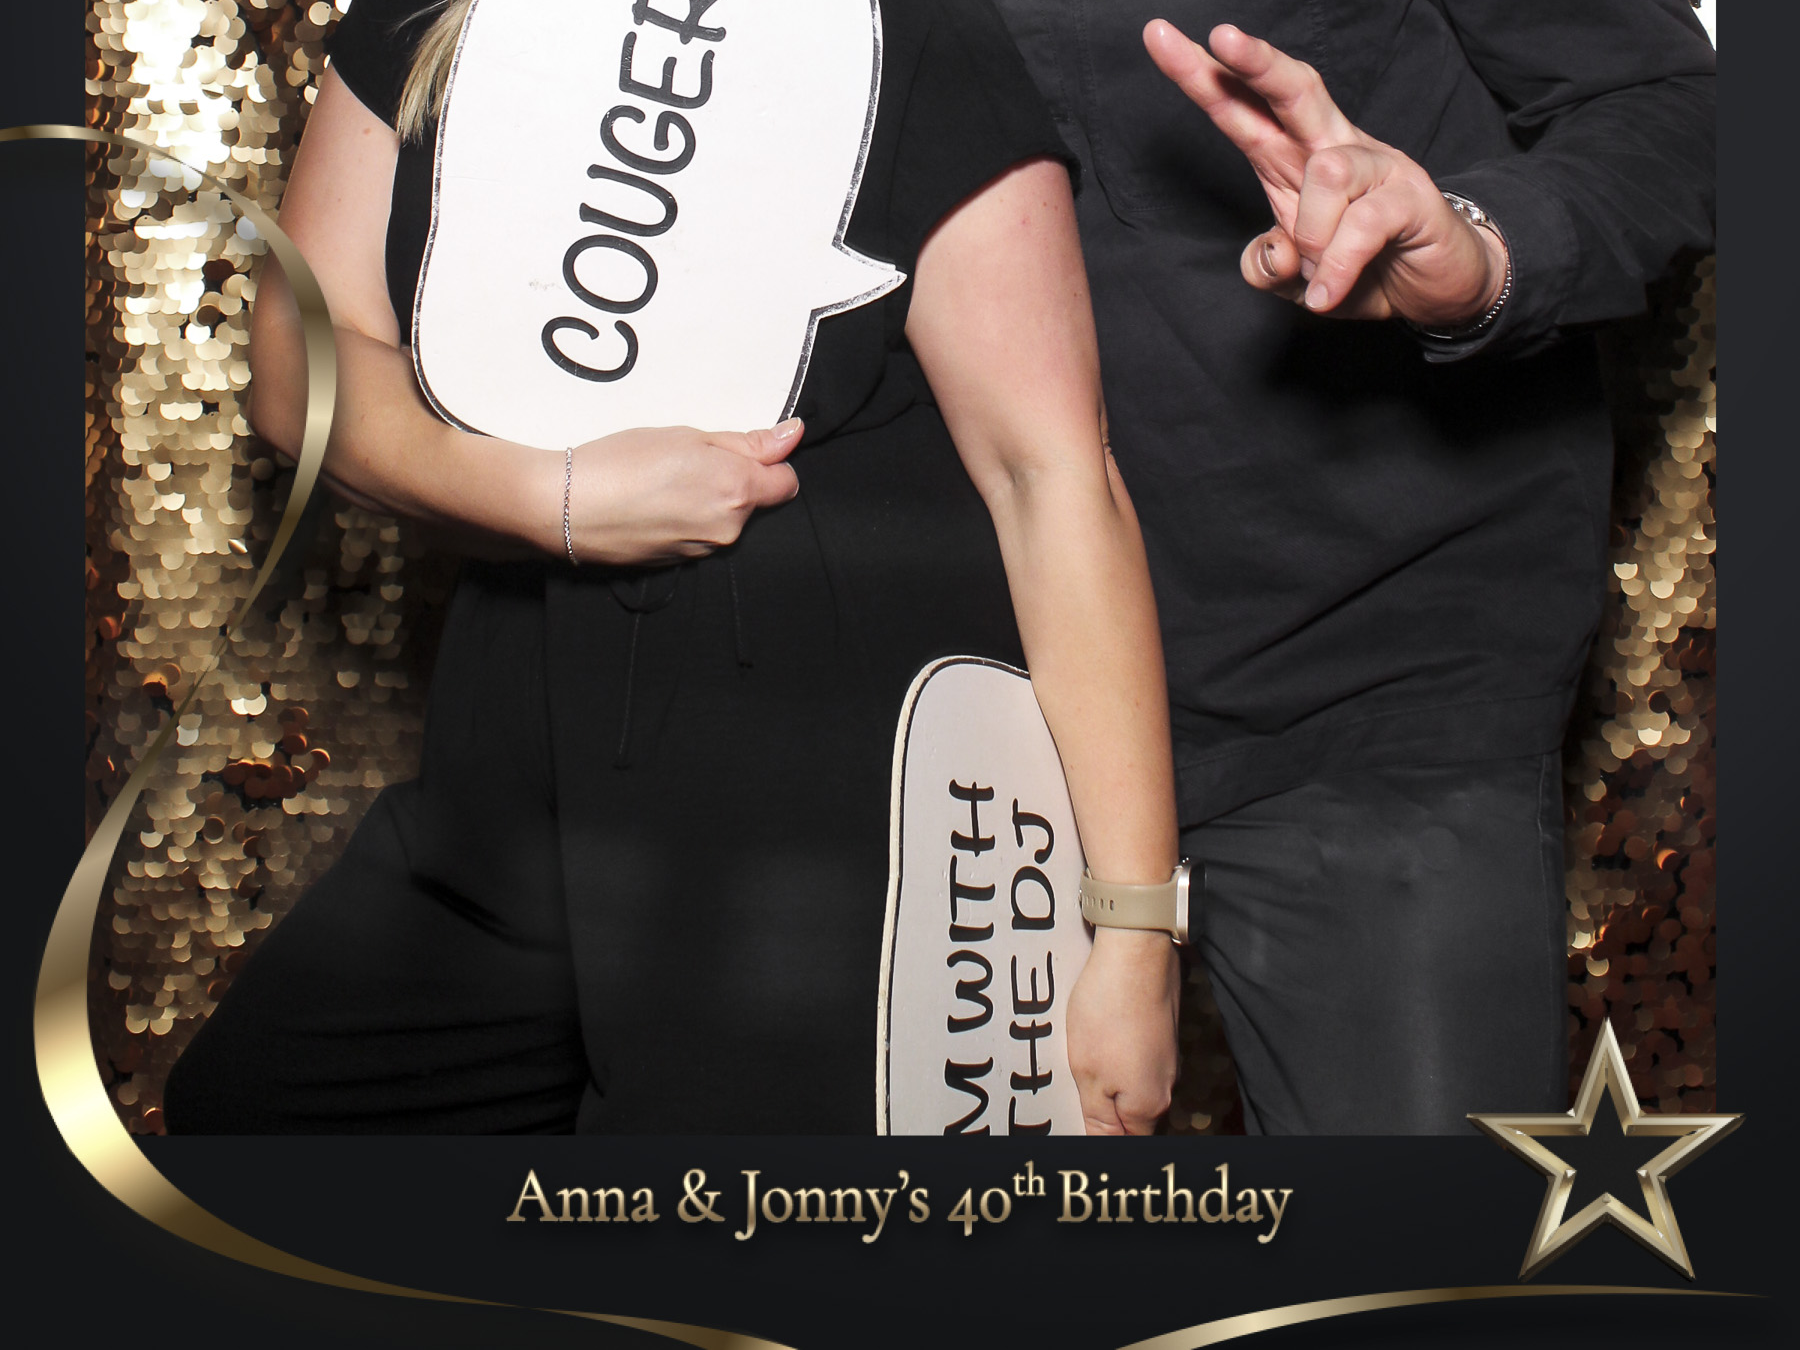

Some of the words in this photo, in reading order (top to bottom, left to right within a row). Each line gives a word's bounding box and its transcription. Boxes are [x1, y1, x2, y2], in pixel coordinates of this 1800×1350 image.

[946, 779, 996, 1034] WITH
[1010, 797, 1056, 931] DJ
[1008, 950, 1055, 1136] THE
